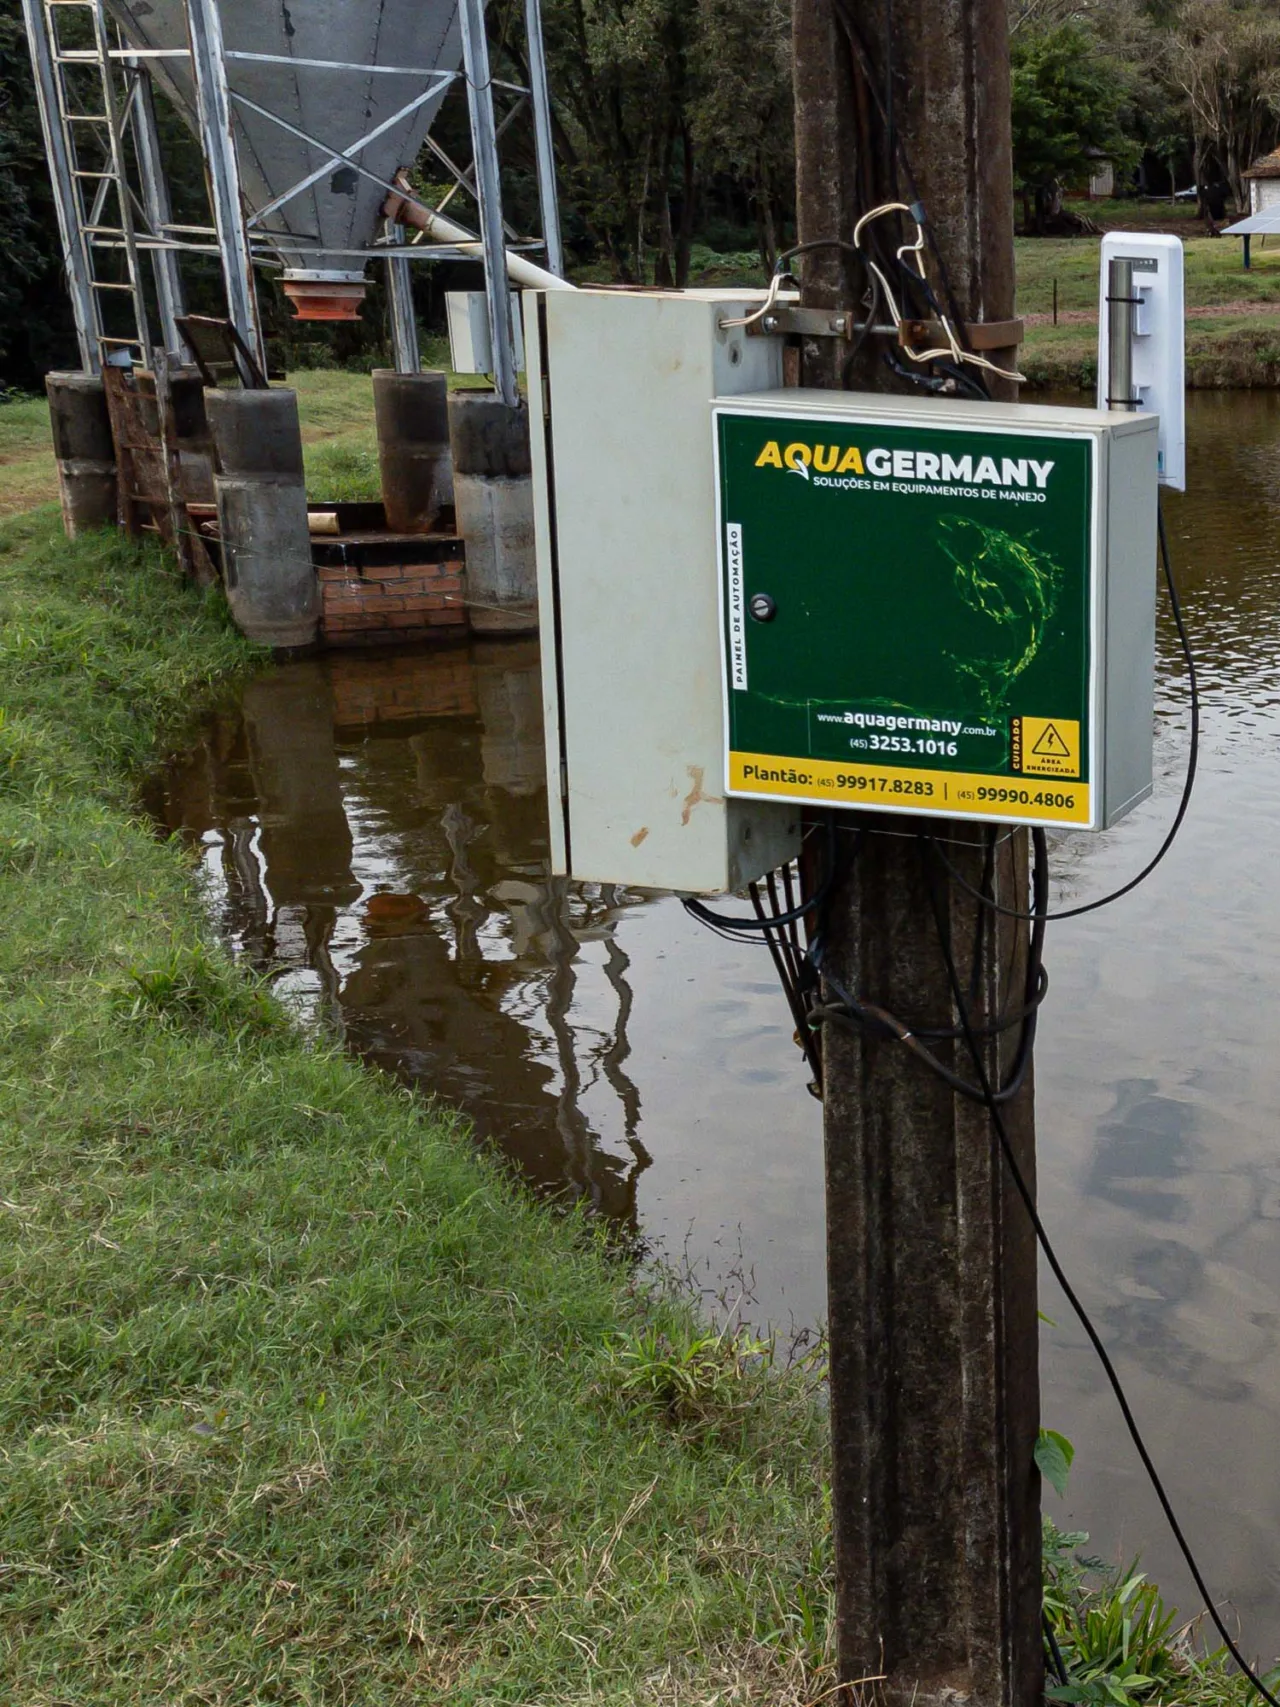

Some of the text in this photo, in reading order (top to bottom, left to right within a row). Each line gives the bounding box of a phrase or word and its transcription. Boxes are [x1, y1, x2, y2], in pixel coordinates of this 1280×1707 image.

[755, 441, 1055, 488] AQUAGERMANY
[813, 475, 1046, 503] SOLUÇÕES EM EQUIPAMENTOS DE MANEJO
[730, 530, 743, 683] PAINEL DE AUTOMAÇÃO
[817, 712, 997, 737] www.aquagermany.com.br
[850, 735, 958, 756] (45) 3253.1016
[1012, 719, 1020, 769] CUIDADO
[1026, 765, 1075, 774] ENERGIZADA
[1040, 757, 1061, 765] ÁREA
[742, 765, 1075, 809] Plantão: (45) 99917.8283 (45) 99990.4806
